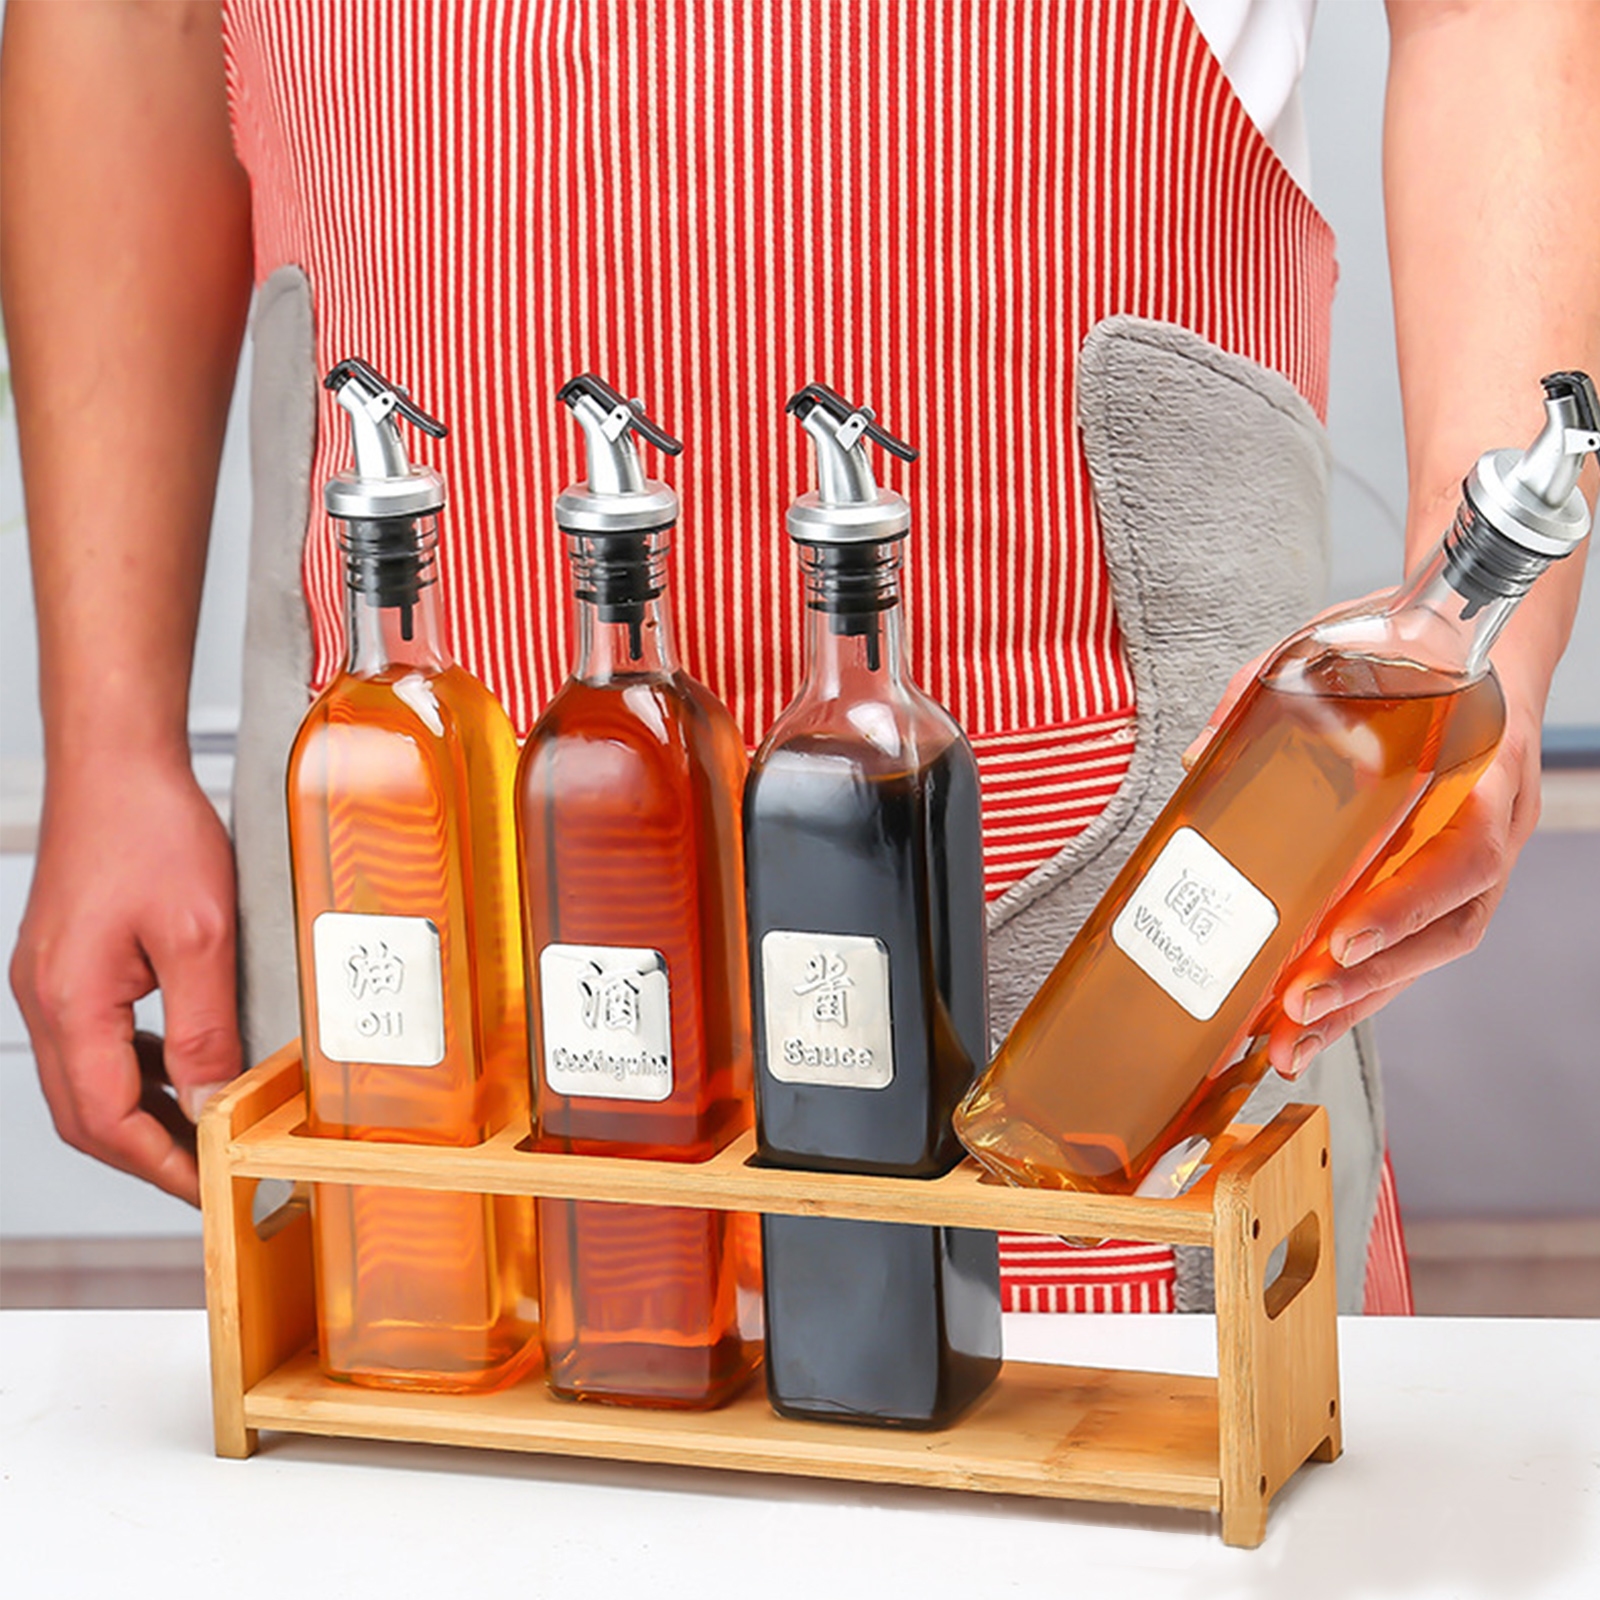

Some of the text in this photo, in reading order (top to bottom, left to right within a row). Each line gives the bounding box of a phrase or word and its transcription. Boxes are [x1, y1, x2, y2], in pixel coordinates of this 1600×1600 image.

[1164, 868, 1234, 946] 醋
[345, 940, 404, 1001] 油
[1133, 904, 1214, 989] Vinegar
[577, 960, 640, 1035] 酒
[784, 1037, 874, 1067] Sauce
